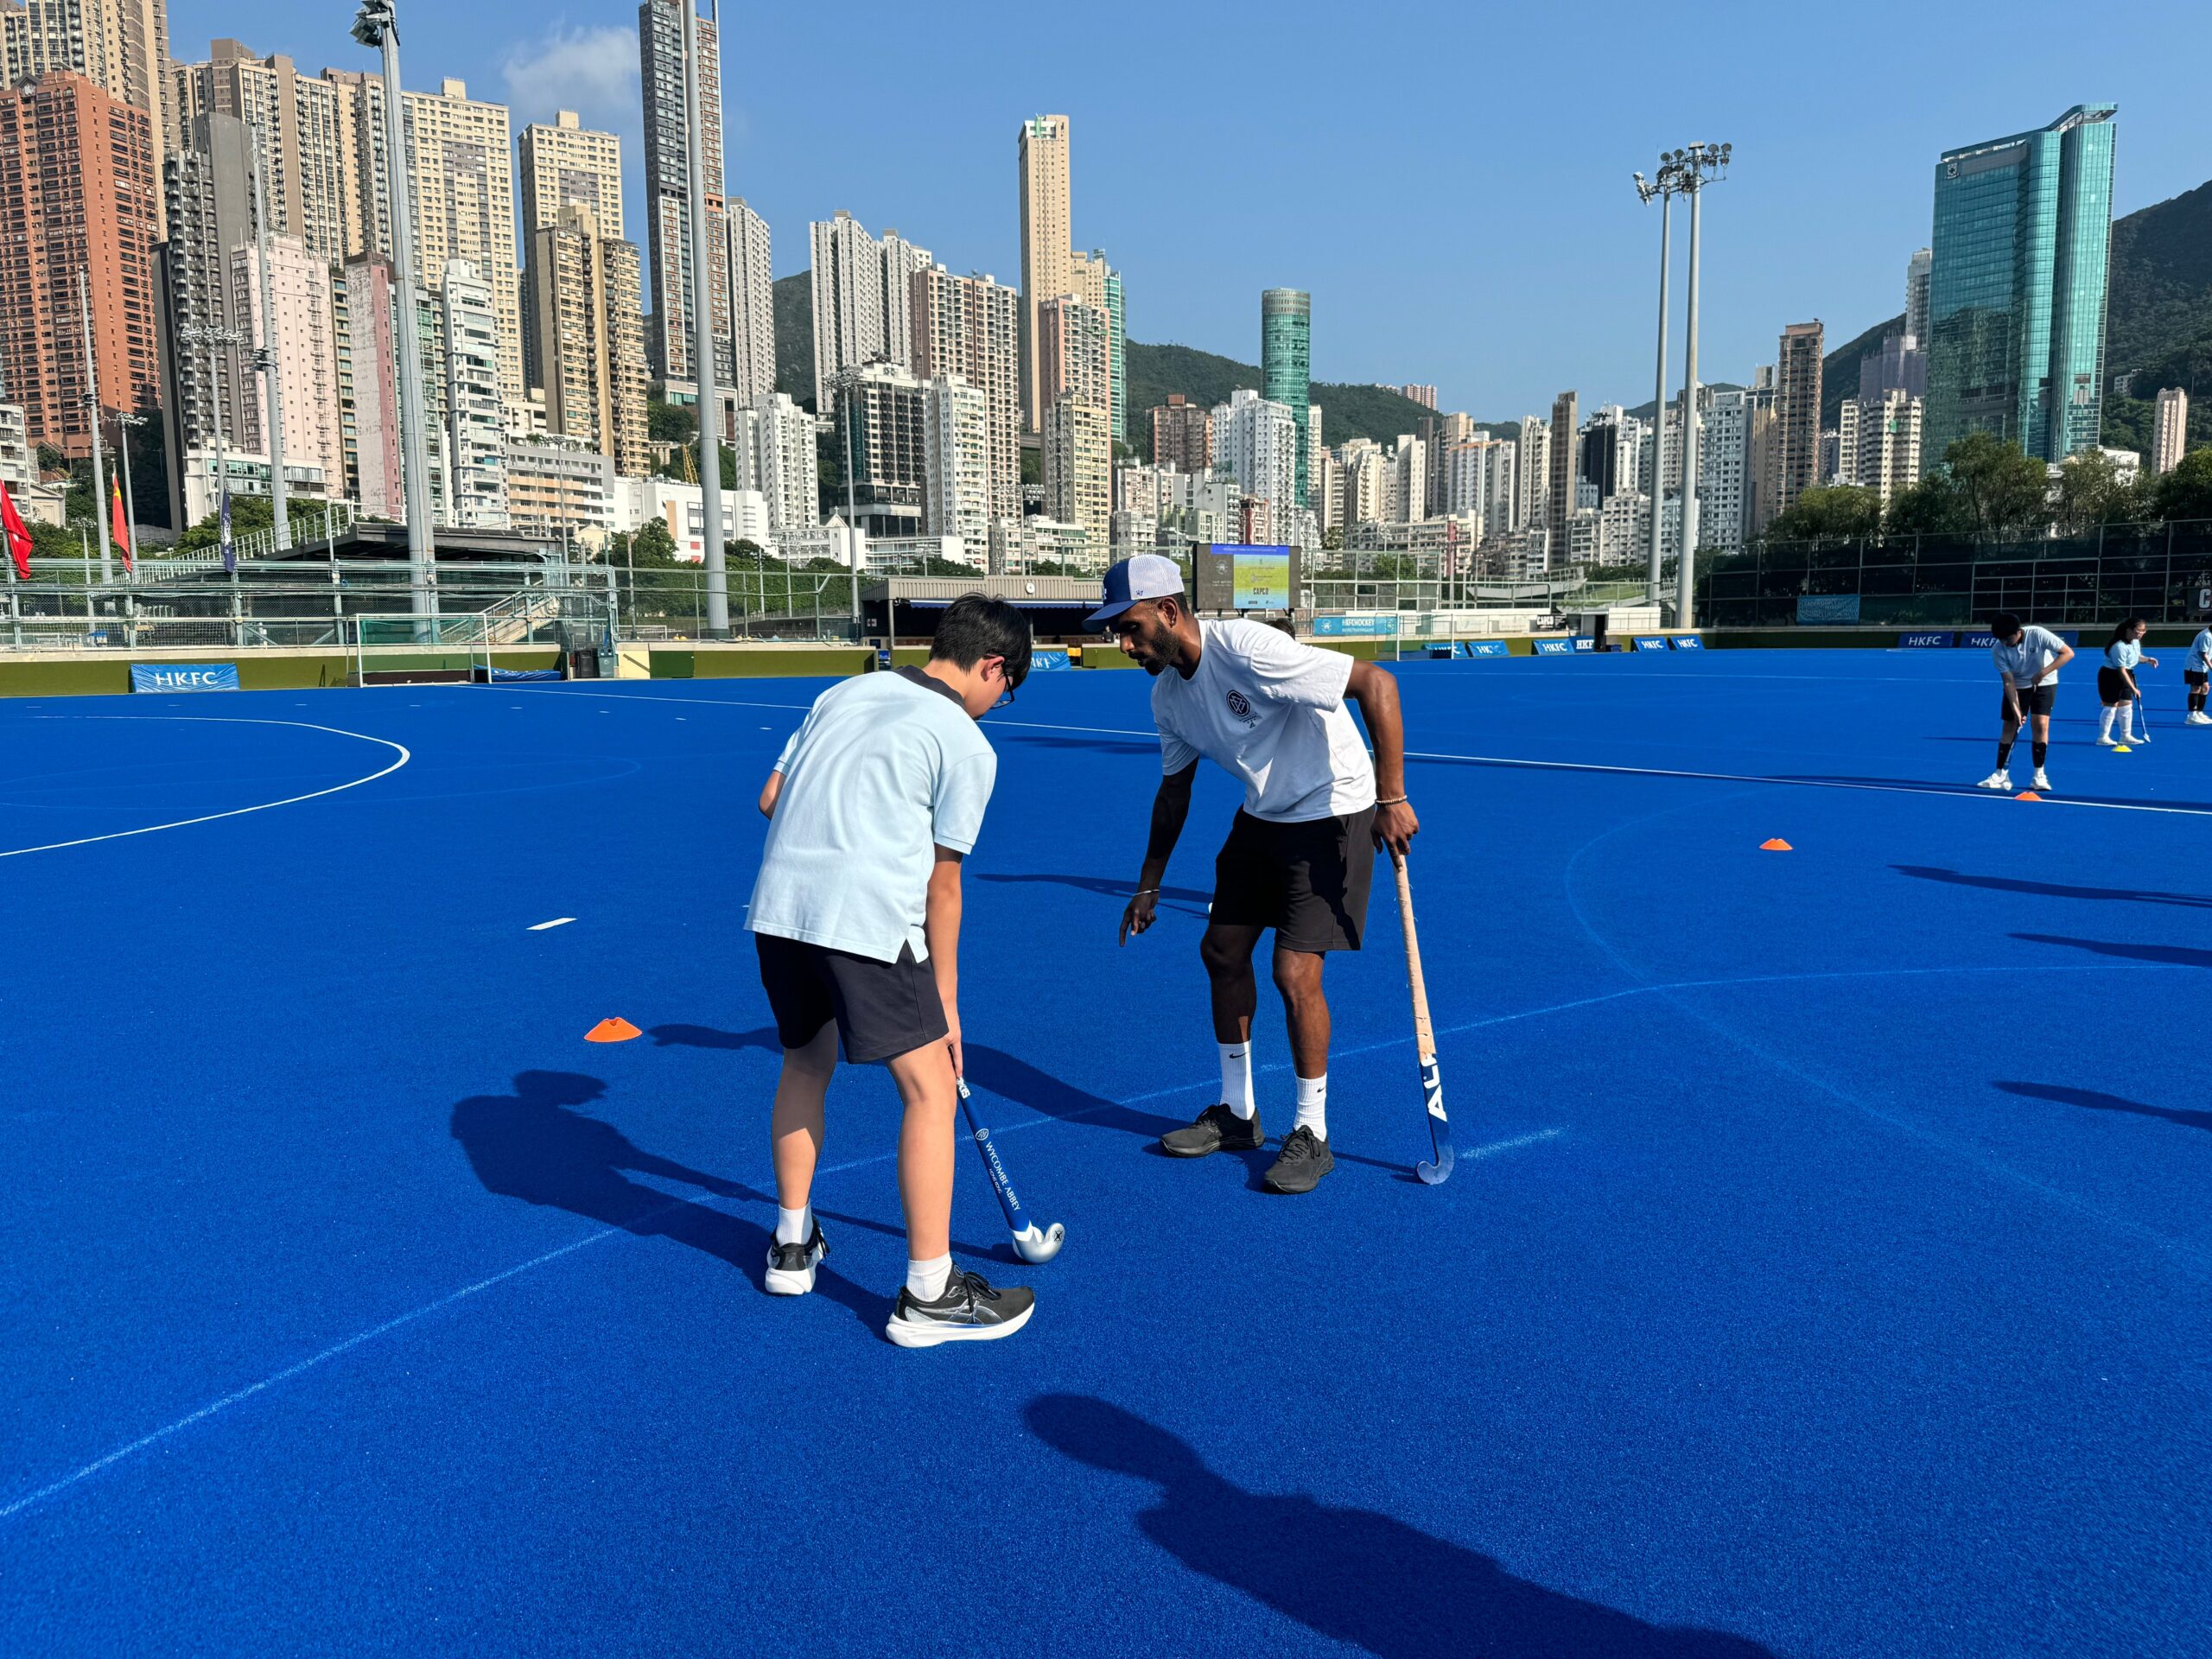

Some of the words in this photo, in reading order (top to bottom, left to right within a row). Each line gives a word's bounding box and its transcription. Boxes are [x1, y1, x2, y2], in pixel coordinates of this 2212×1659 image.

[2199, 588, 2212, 608] C
[1576, 639, 1594, 650] HKF
[1642, 640, 1663, 649] HKFC
[1677, 639, 1698, 648] HKFC
[1908, 636, 1942, 646] HKFC
[1971, 638, 1998, 647] HKF
[1542, 642, 1567, 652] HKFC
[155, 671, 218, 685] HKFC
[986, 1141, 1009, 1186] WYCOMBE
[1004, 1186, 1021, 1211] ABBEY
